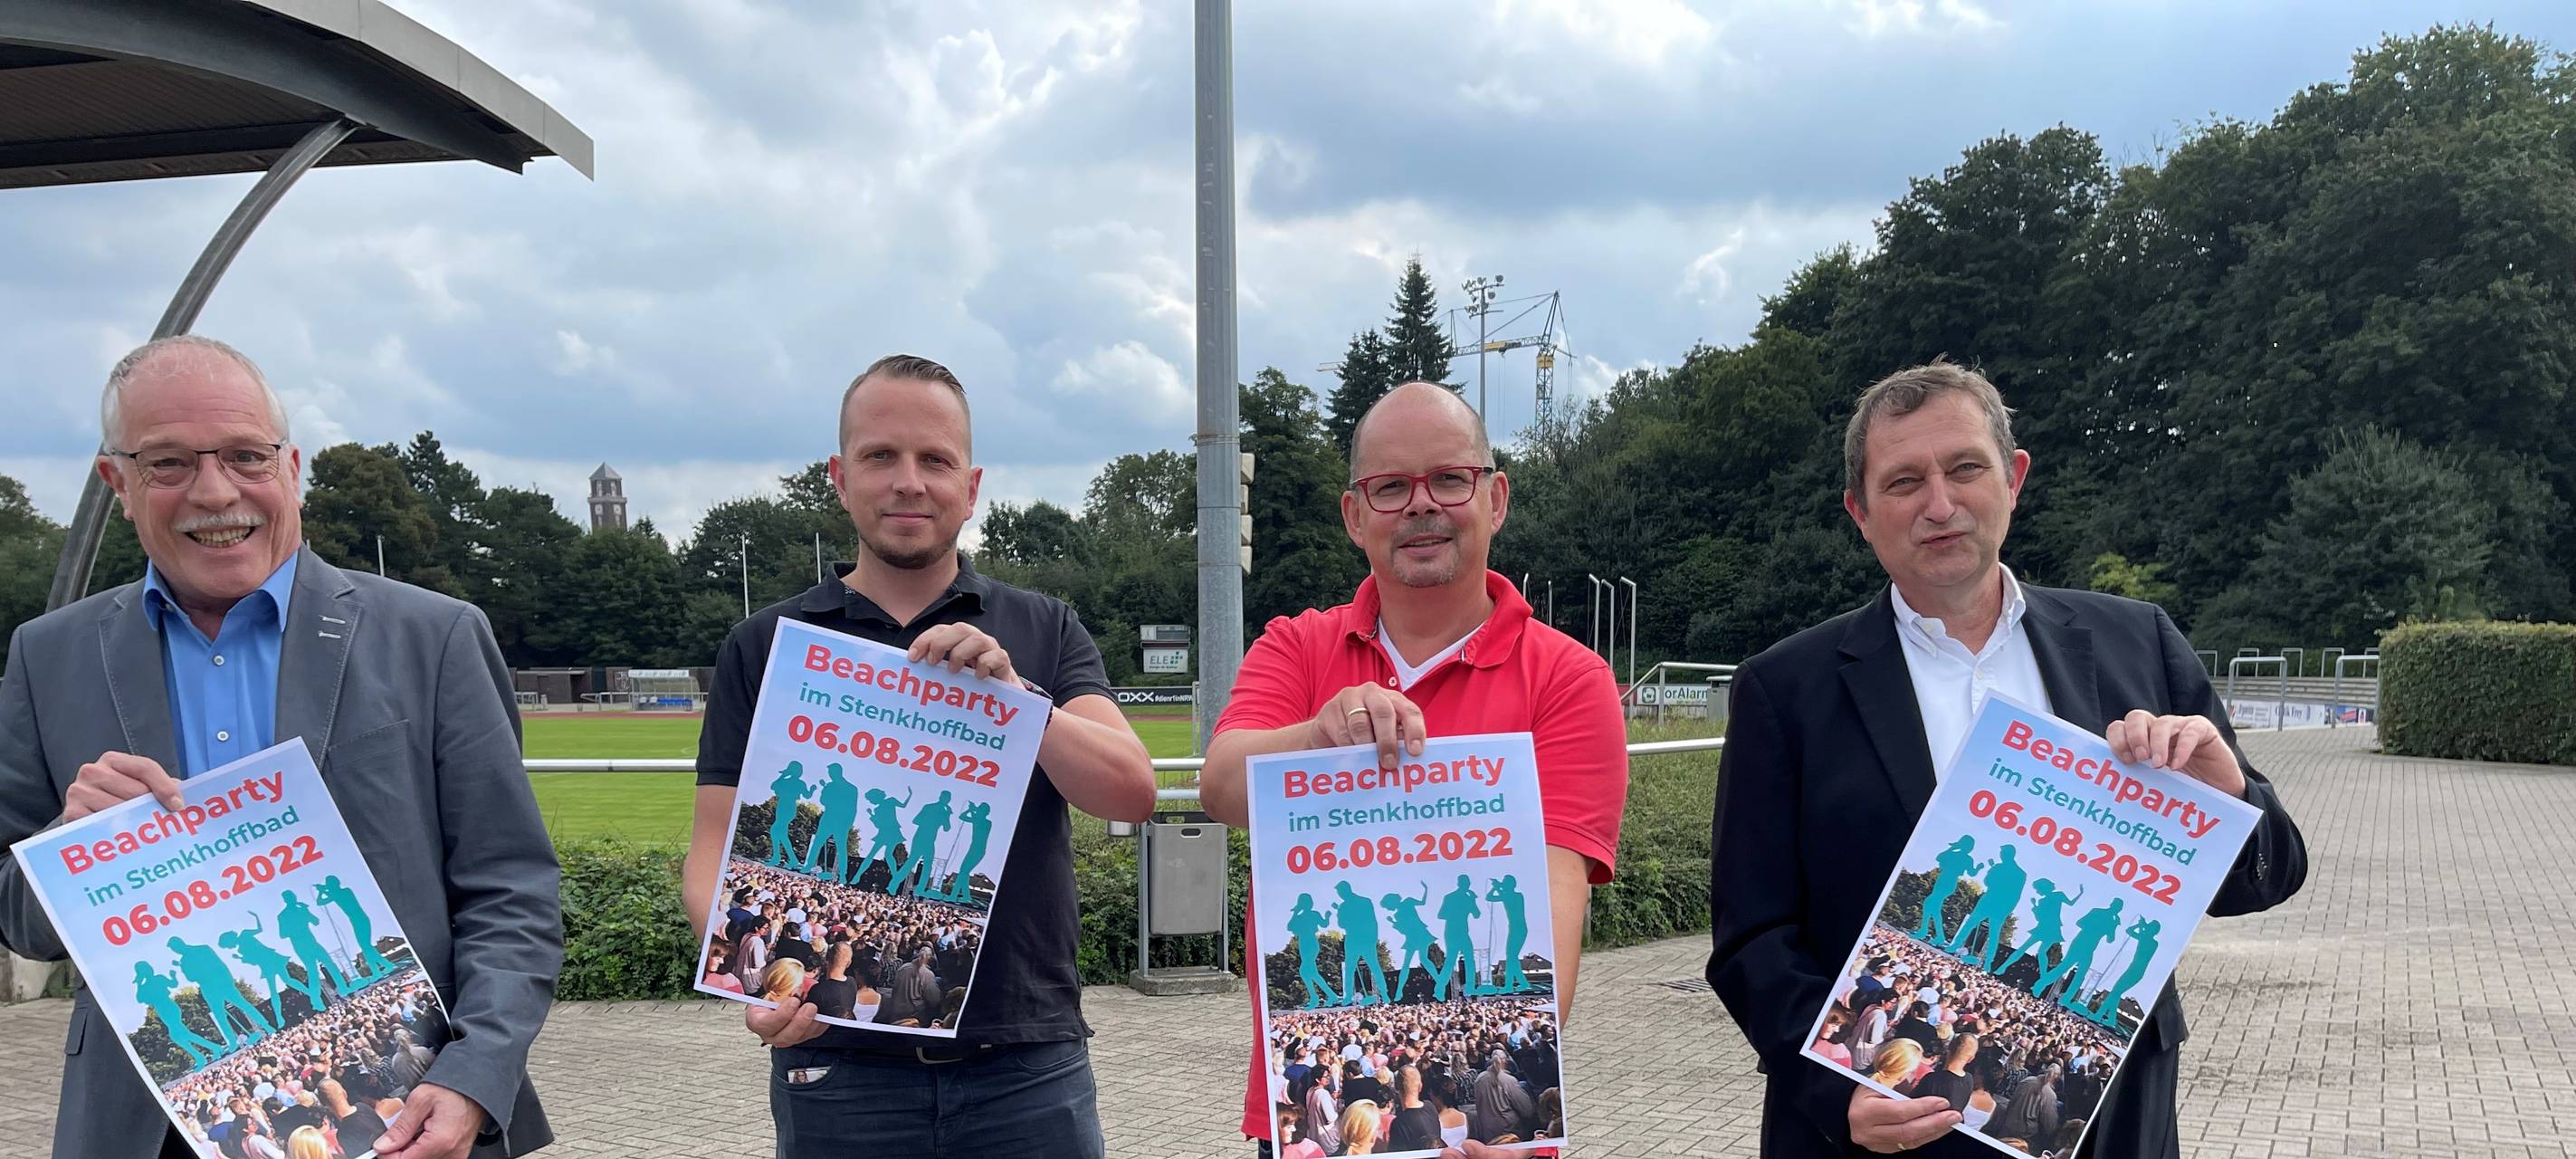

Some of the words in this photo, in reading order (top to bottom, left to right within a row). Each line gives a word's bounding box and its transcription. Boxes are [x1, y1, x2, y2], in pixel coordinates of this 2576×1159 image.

[804, 644, 1019, 726] Beachparty
[1116, 692, 1154, 703] OXX
[1150, 656, 1169, 665] ELE
[787, 714, 1001, 787] 06.08.2022
[799, 682, 832, 707] im
[838, 694, 1007, 751] Stenkhoffbad
[1283, 754, 1505, 799] Beachparty
[1289, 811, 1320, 831] im
[1328, 793, 1504, 828] Stenkhoffbad
[1989, 757, 2022, 787] im
[2027, 777, 2197, 866] Stenkhoffbad
[2001, 720, 2220, 838] Beachparty
[60, 771, 285, 876] Beachparty
[84, 881, 123, 907] im
[126, 806, 300, 889] Stenkhoffbad
[1286, 827, 1513, 874] 06.08.2022
[1969, 790, 2182, 905] 06.08.2022
[102, 835, 324, 947] 06.08.2022
